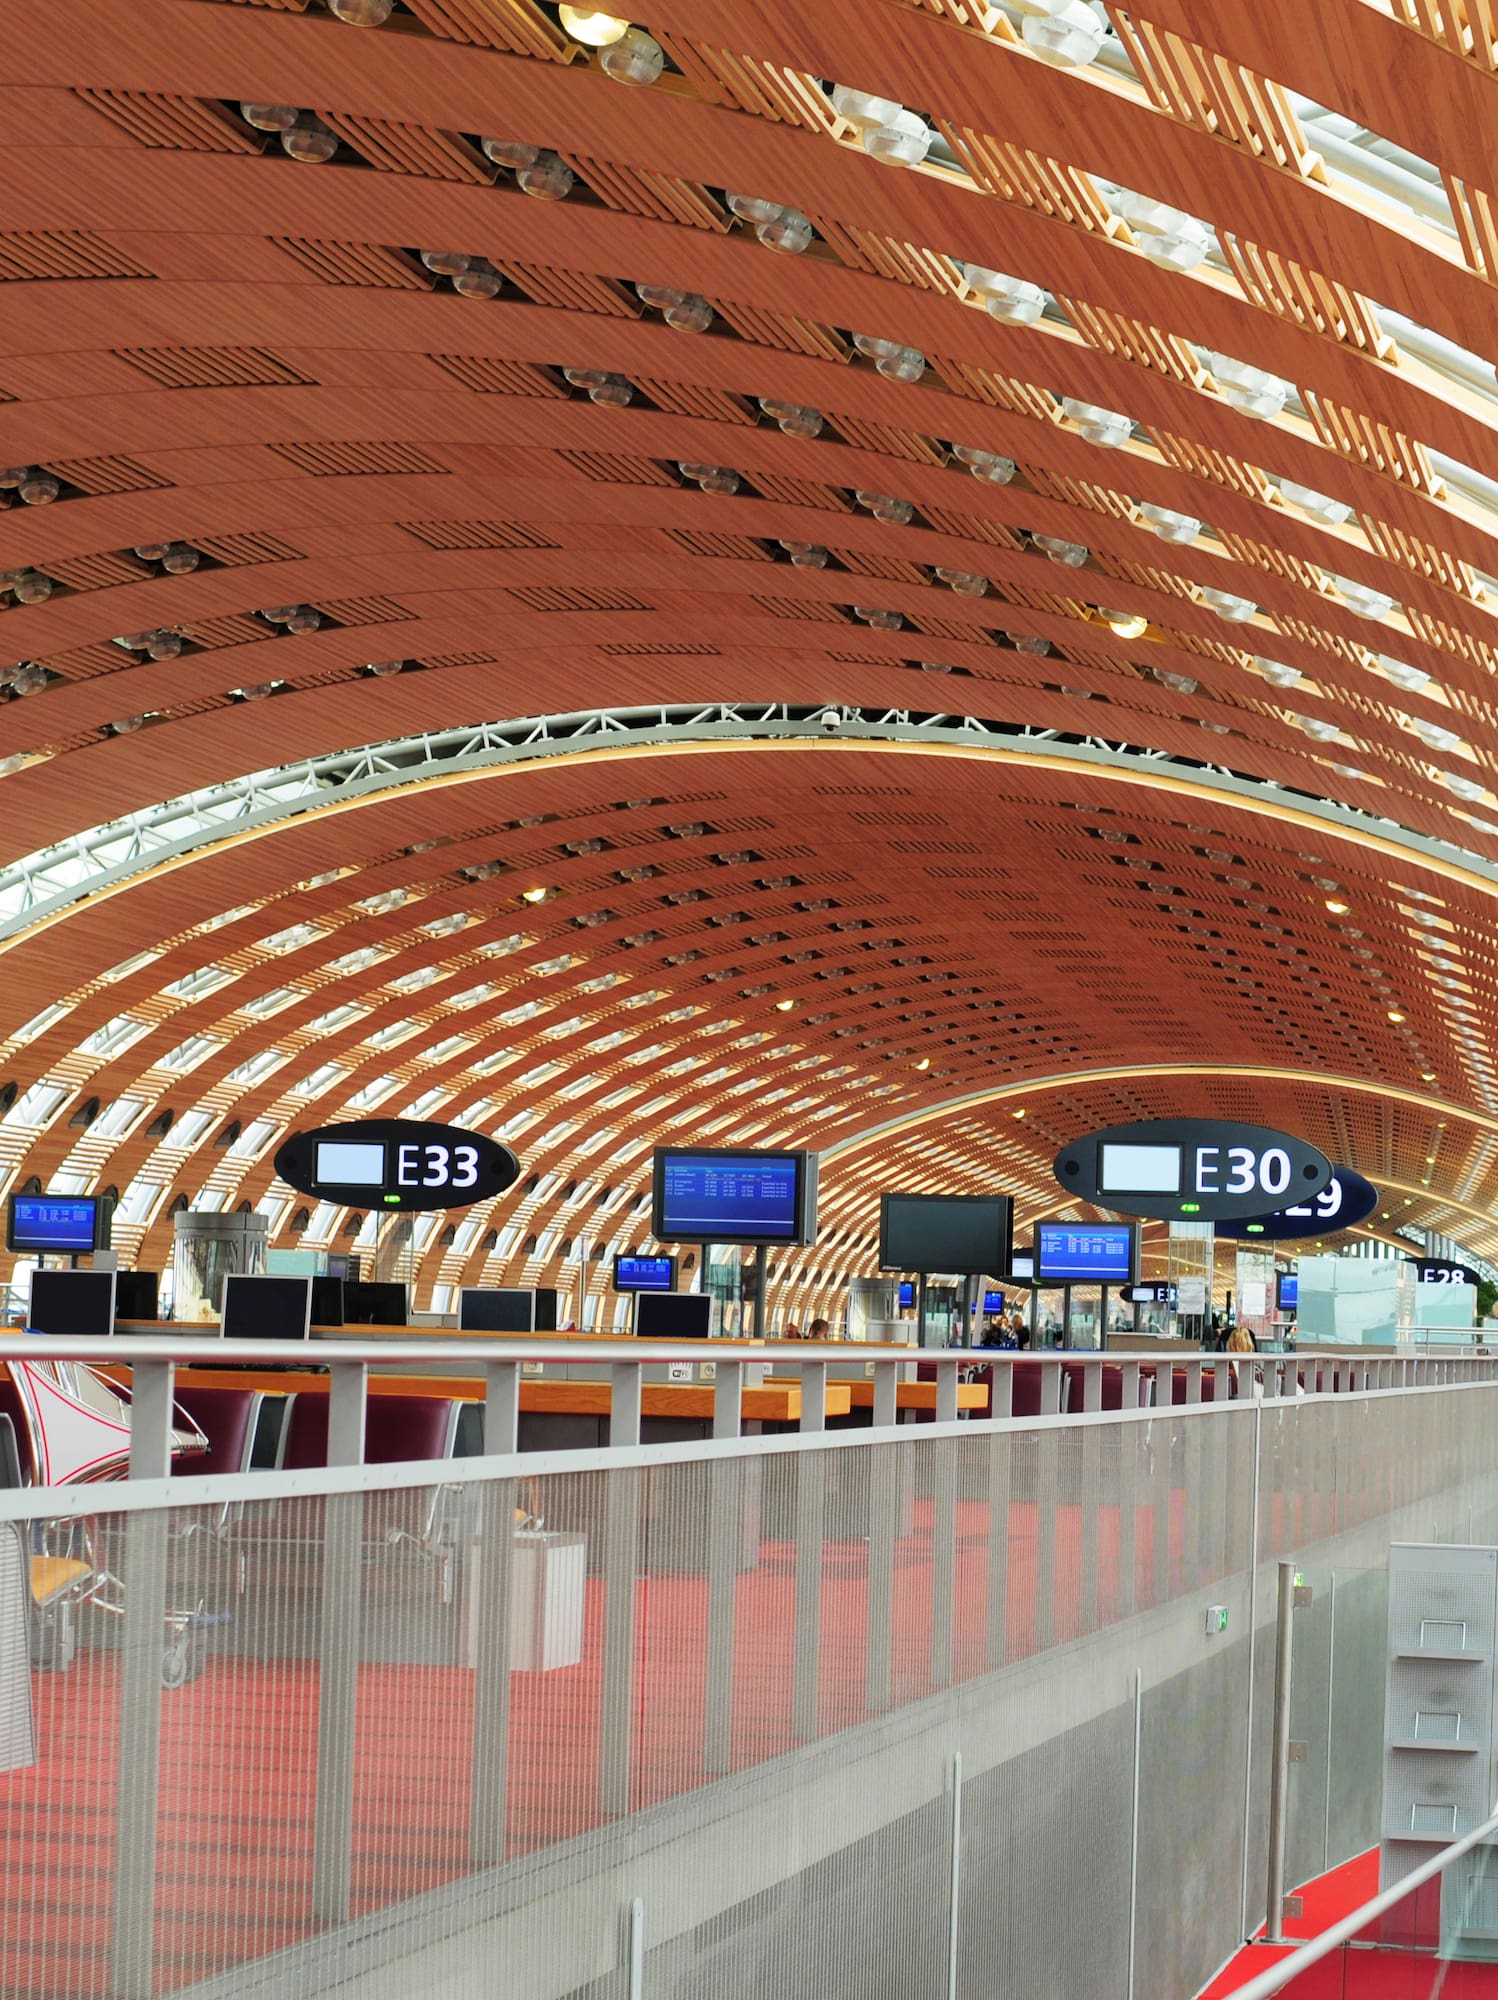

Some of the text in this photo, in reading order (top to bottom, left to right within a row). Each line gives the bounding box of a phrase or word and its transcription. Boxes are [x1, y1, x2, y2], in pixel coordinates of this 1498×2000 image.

[398, 1144, 479, 1188] E33
[1195, 1147, 1291, 1195] E30
[1157, 1287, 1180, 1302] E3
